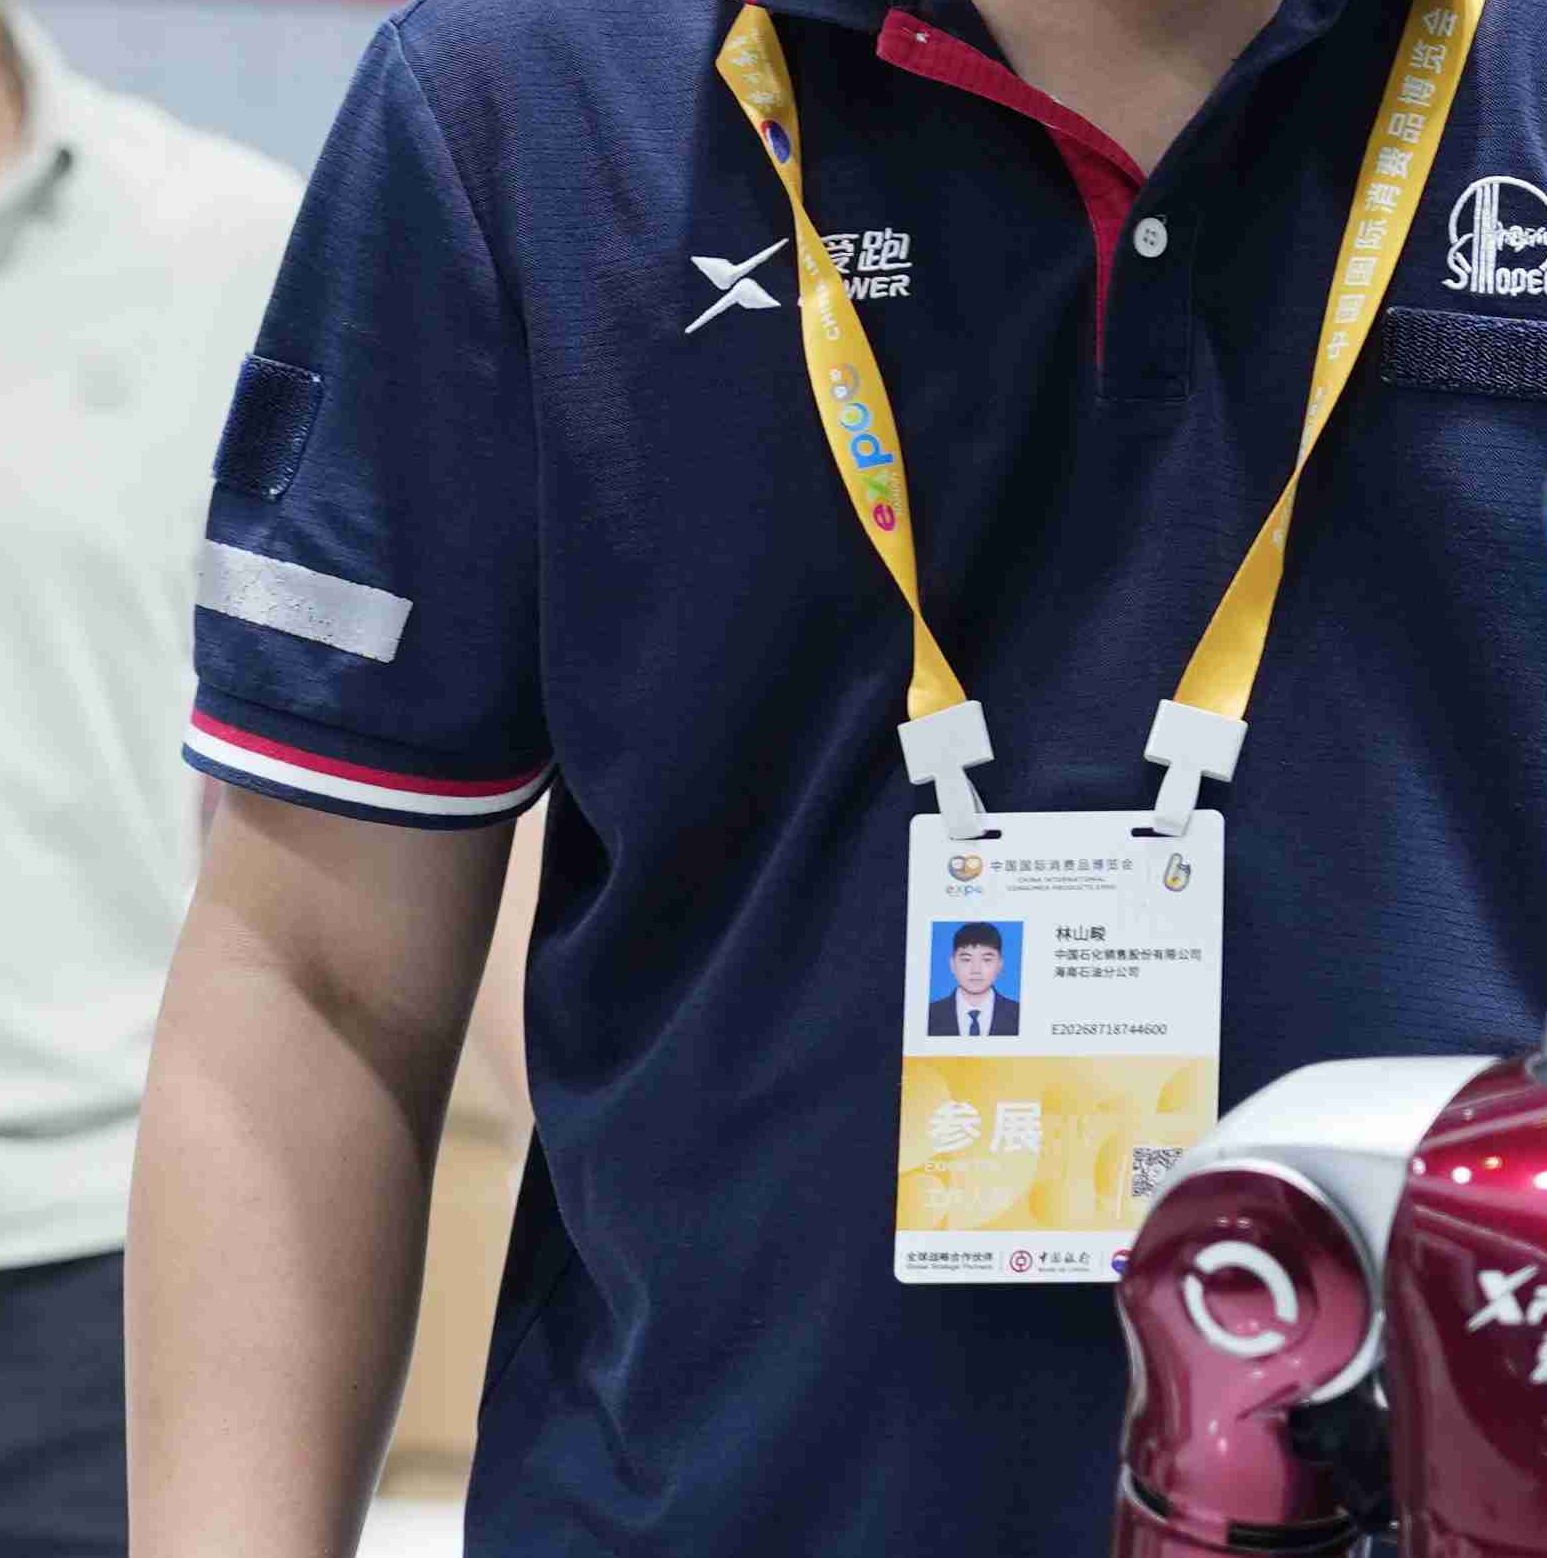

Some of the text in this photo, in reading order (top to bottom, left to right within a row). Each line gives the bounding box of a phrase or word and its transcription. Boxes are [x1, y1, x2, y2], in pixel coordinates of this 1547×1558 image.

[1326, 8, 1459, 362] 中国国际消费品博览会
